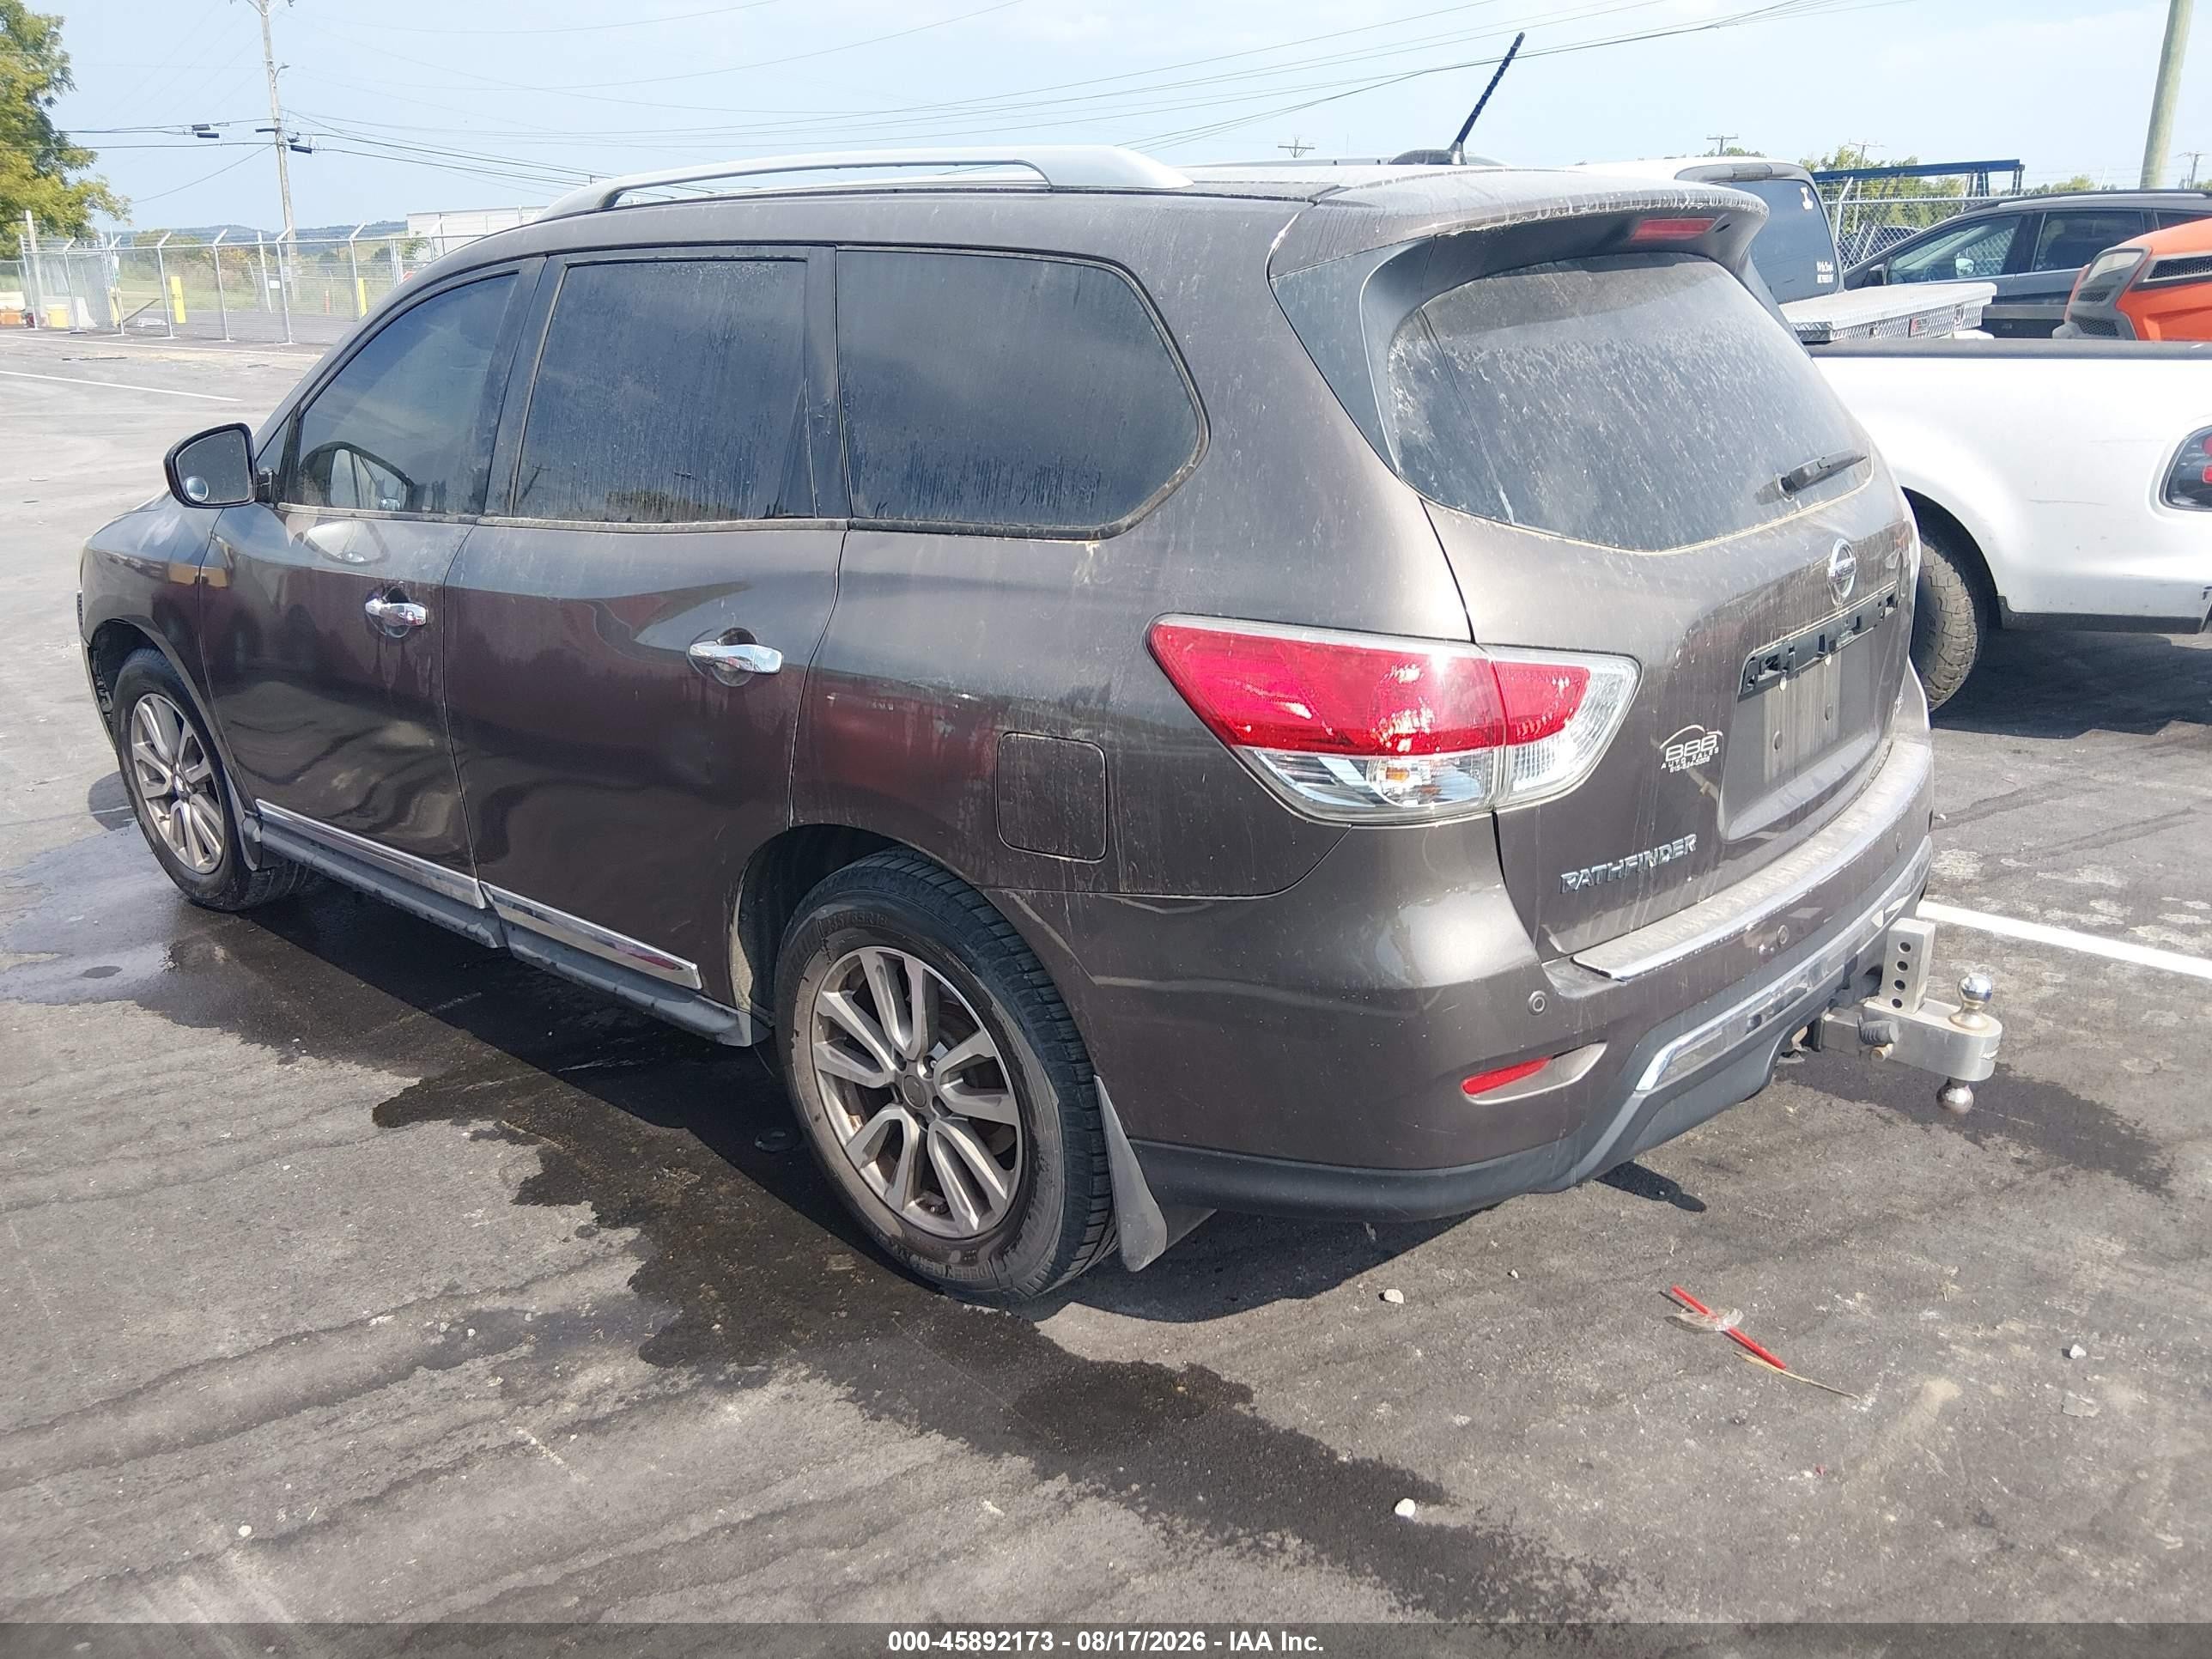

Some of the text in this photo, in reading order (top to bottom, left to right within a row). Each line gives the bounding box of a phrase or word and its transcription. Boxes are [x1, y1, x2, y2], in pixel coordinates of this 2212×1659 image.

[1661, 747, 1719, 769] AUTO SALES
[1665, 734, 1717, 762] BBB
[1559, 833, 1698, 894] PATHFINDER
